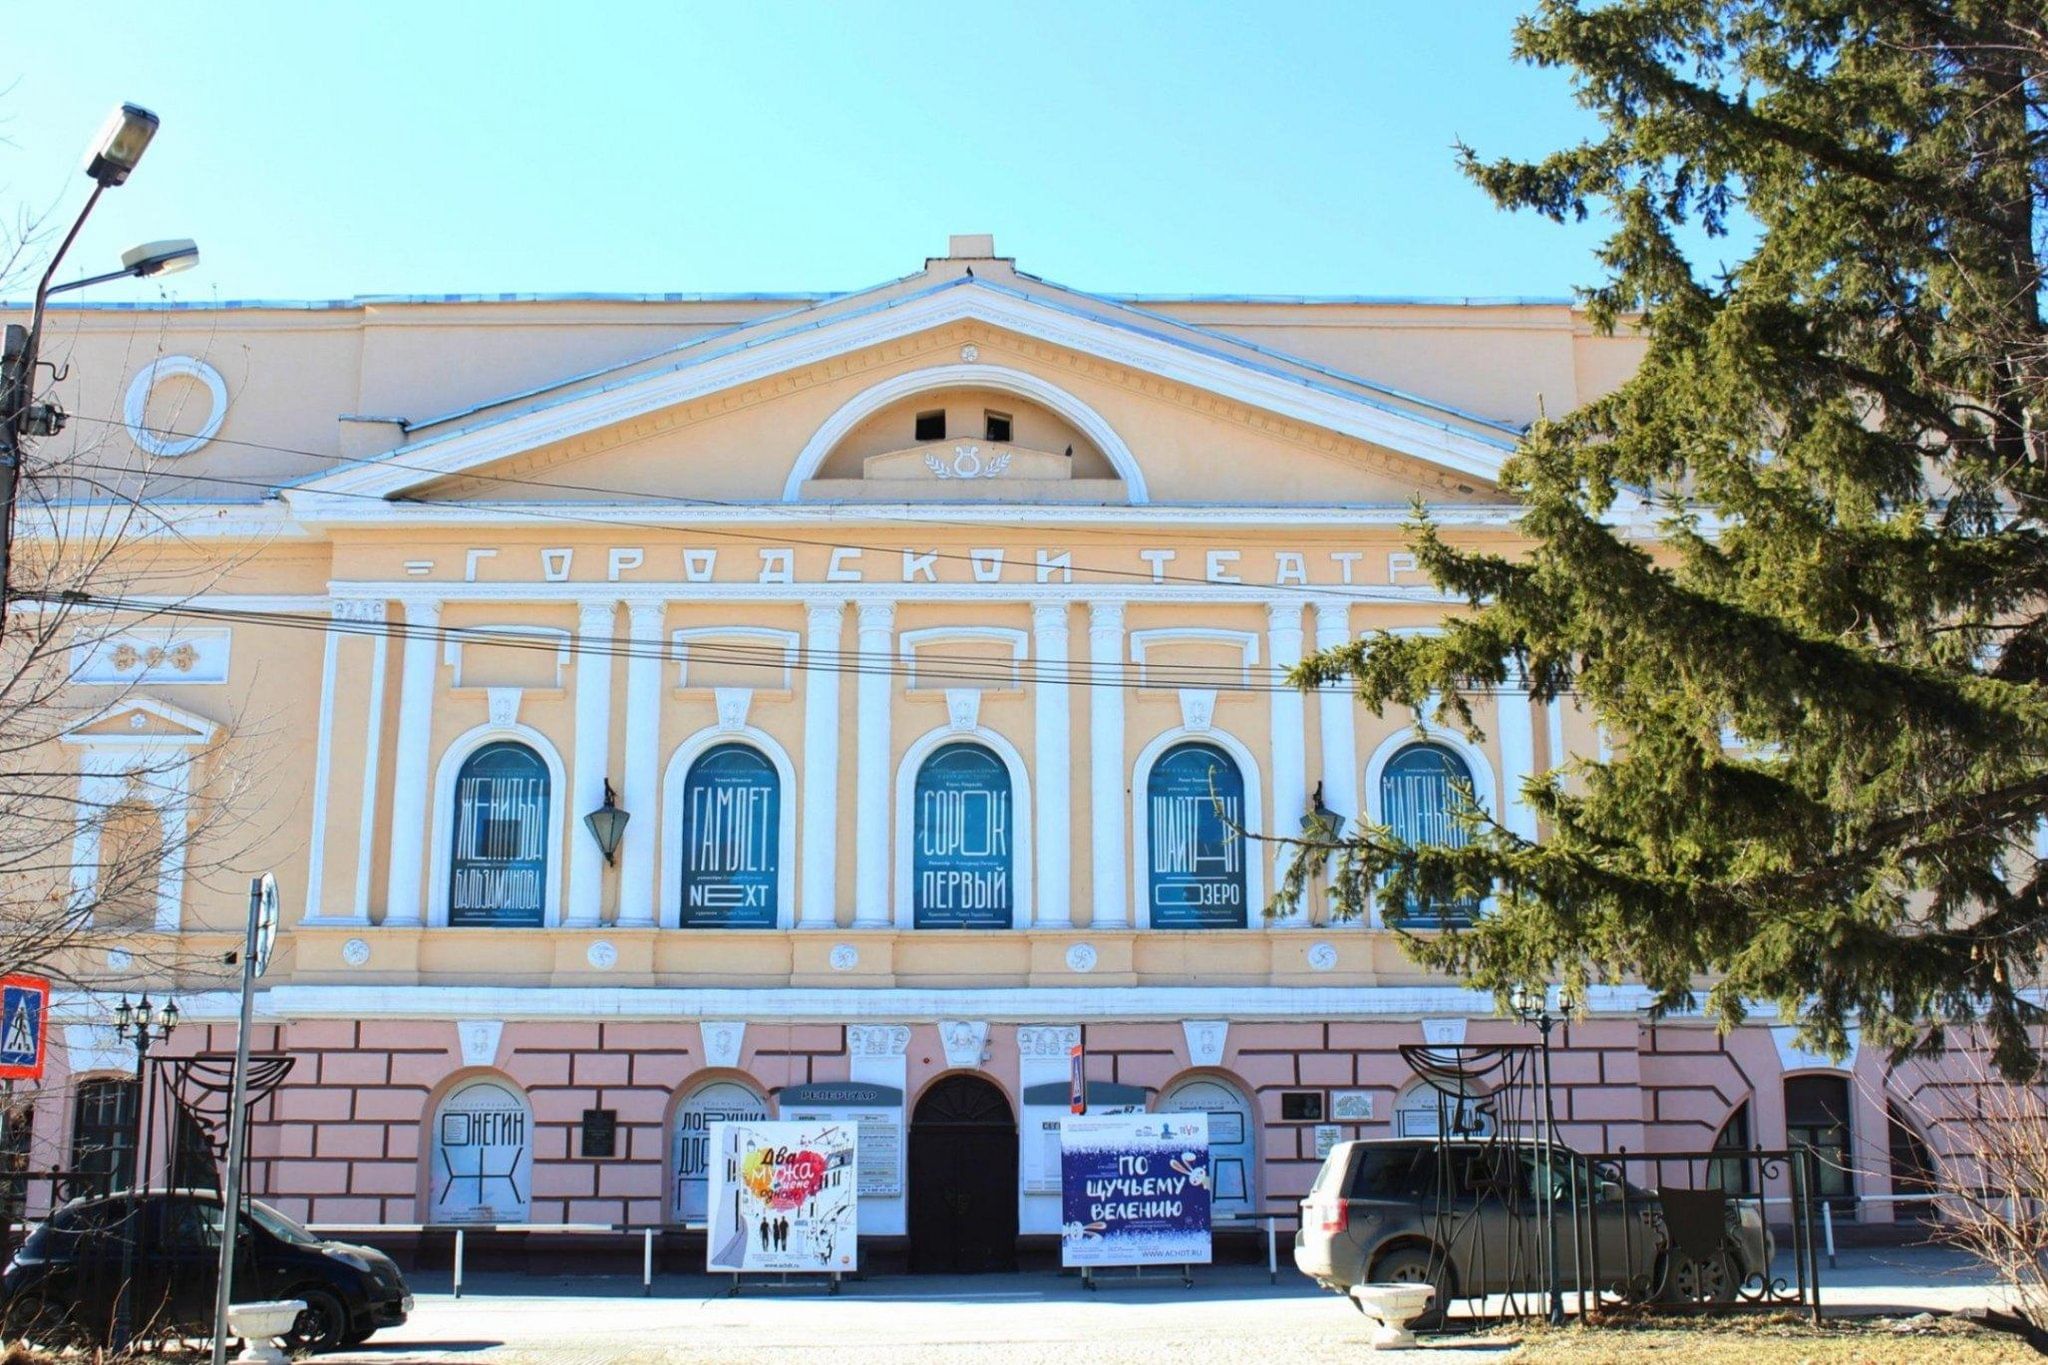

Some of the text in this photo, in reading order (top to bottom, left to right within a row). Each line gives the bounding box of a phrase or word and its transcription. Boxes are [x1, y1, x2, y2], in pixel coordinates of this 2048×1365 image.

[457, 778, 544, 860] ЖЕНИТЬБА
[691, 786, 775, 872] ГАМЛЕТ.
[923, 789, 1007, 856] СОРОК
[454, 868, 540, 910] БАЛЬЗАМИНОВА
[690, 884, 769, 907] NEXT
[923, 867, 1007, 909] ПЕРВЫЙ
[1155, 883, 1240, 905] ОЗЕРО
[441, 1112, 524, 1146] ОНЕГИН
[760, 1146, 797, 1166] Два
[1119, 1155, 1148, 1176] ПО
[1086, 1176, 1185, 1202] ЩУЧЬЕМУ
[1090, 1200, 1183, 1221] ВЕЛЕНИЮ
